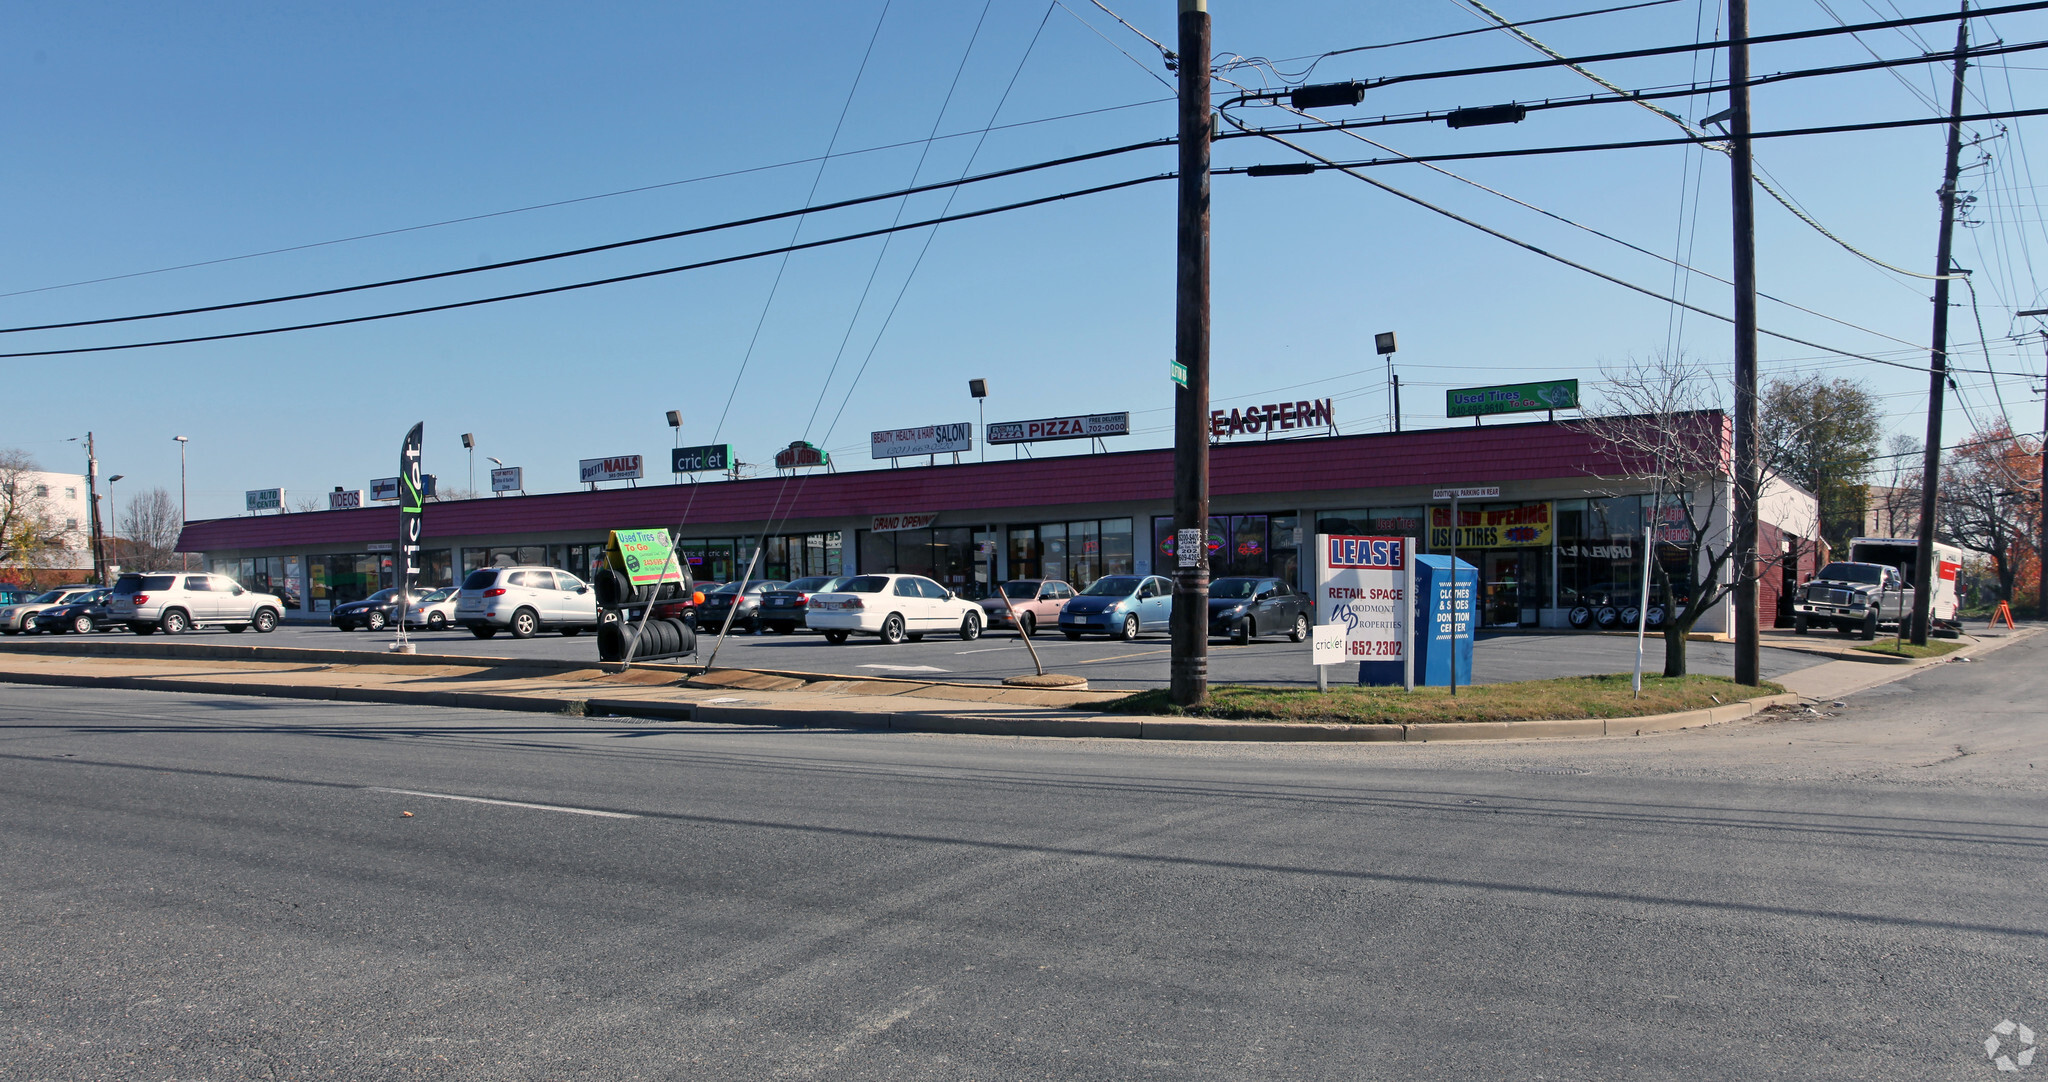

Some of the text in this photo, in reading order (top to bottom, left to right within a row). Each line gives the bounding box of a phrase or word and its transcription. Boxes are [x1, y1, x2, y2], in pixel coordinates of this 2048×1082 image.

[1454, 390, 1520, 405] Used Tires
[1509, 400, 1520, 408] To
[1211, 398, 1333, 436] EASTERN
[922, 427, 935, 439] HAIR
[935, 423, 965, 443] SALON
[1029, 420, 1084, 437] PIZZA
[1088, 423, 1125, 432] 702-0000
[990, 432, 1023, 440] PIZZA
[604, 456, 638, 472] NAILS
[678, 446, 722, 470] cricket
[260, 491, 278, 500] AUTO
[1460, 488, 1480, 496] PARKING
[256, 500, 281, 509] CENTER
[329, 492, 360, 507] VIDEOS
[1487, 503, 1548, 526] OPENING
[1665, 506, 1686, 525] Major
[873, 517, 900, 530] GRAND
[1376, 517, 1416, 530] Used Tires
[618, 531, 655, 543] Used Tires
[1432, 528, 1463, 546] USD
[1465, 527, 1498, 546] TIRES
[1664, 526, 1690, 541] Brands
[636, 543, 648, 551] Go
[1330, 538, 1401, 567] LEASE
[1328, 587, 1366, 599] RETAIL
[1370, 589, 1403, 600] SPACE
[1439, 600, 1469, 610] & SOES
[1437, 612, 1470, 622] DONTION
[1315, 635, 1343, 650] cricket
